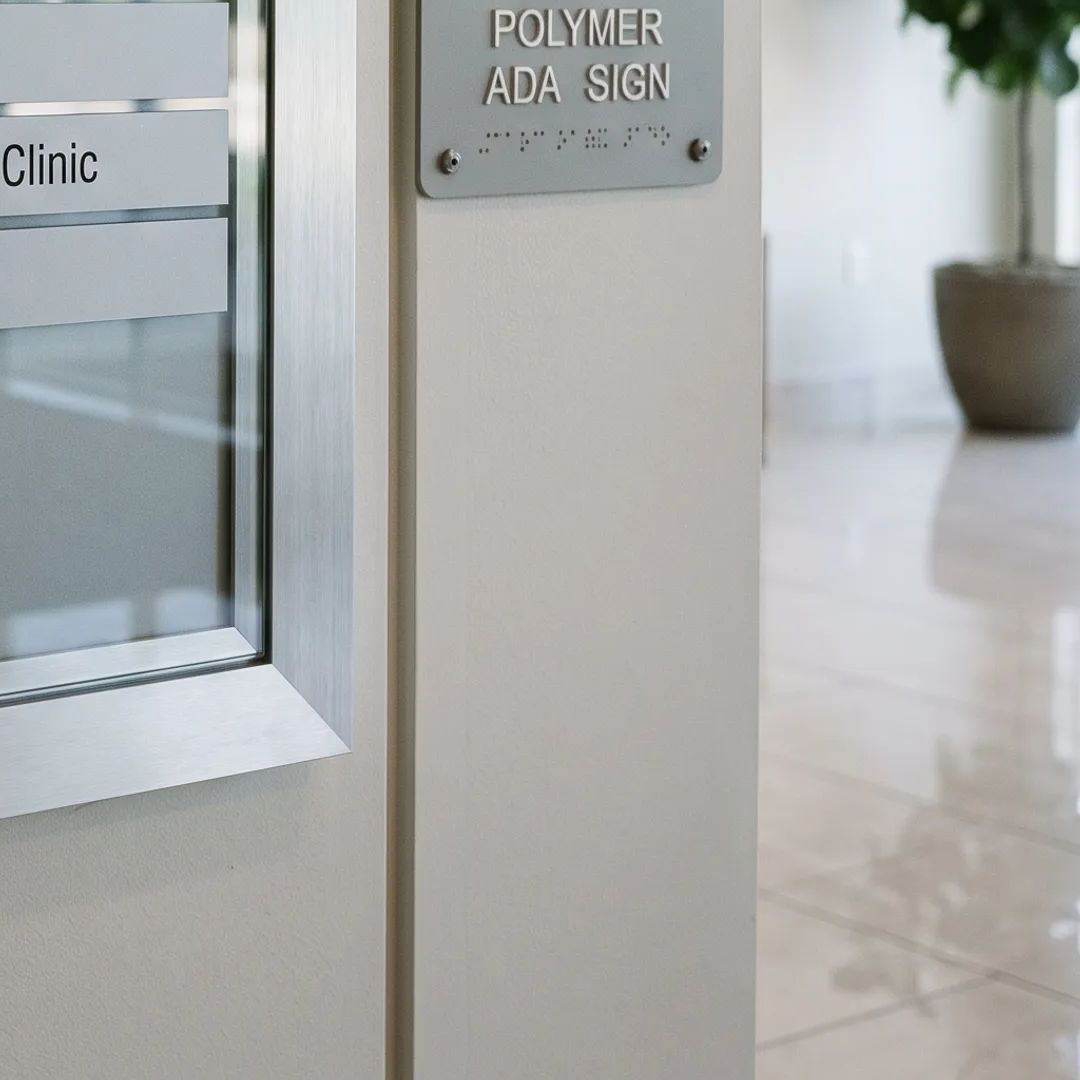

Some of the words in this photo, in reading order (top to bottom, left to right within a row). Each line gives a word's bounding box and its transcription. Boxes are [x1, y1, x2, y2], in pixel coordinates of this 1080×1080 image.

[491, 7, 664, 49] POLYMER
[483, 64, 562, 106] ADA
[583, 62, 671, 103] SIGN
[2, 142, 98, 187] Clinic
